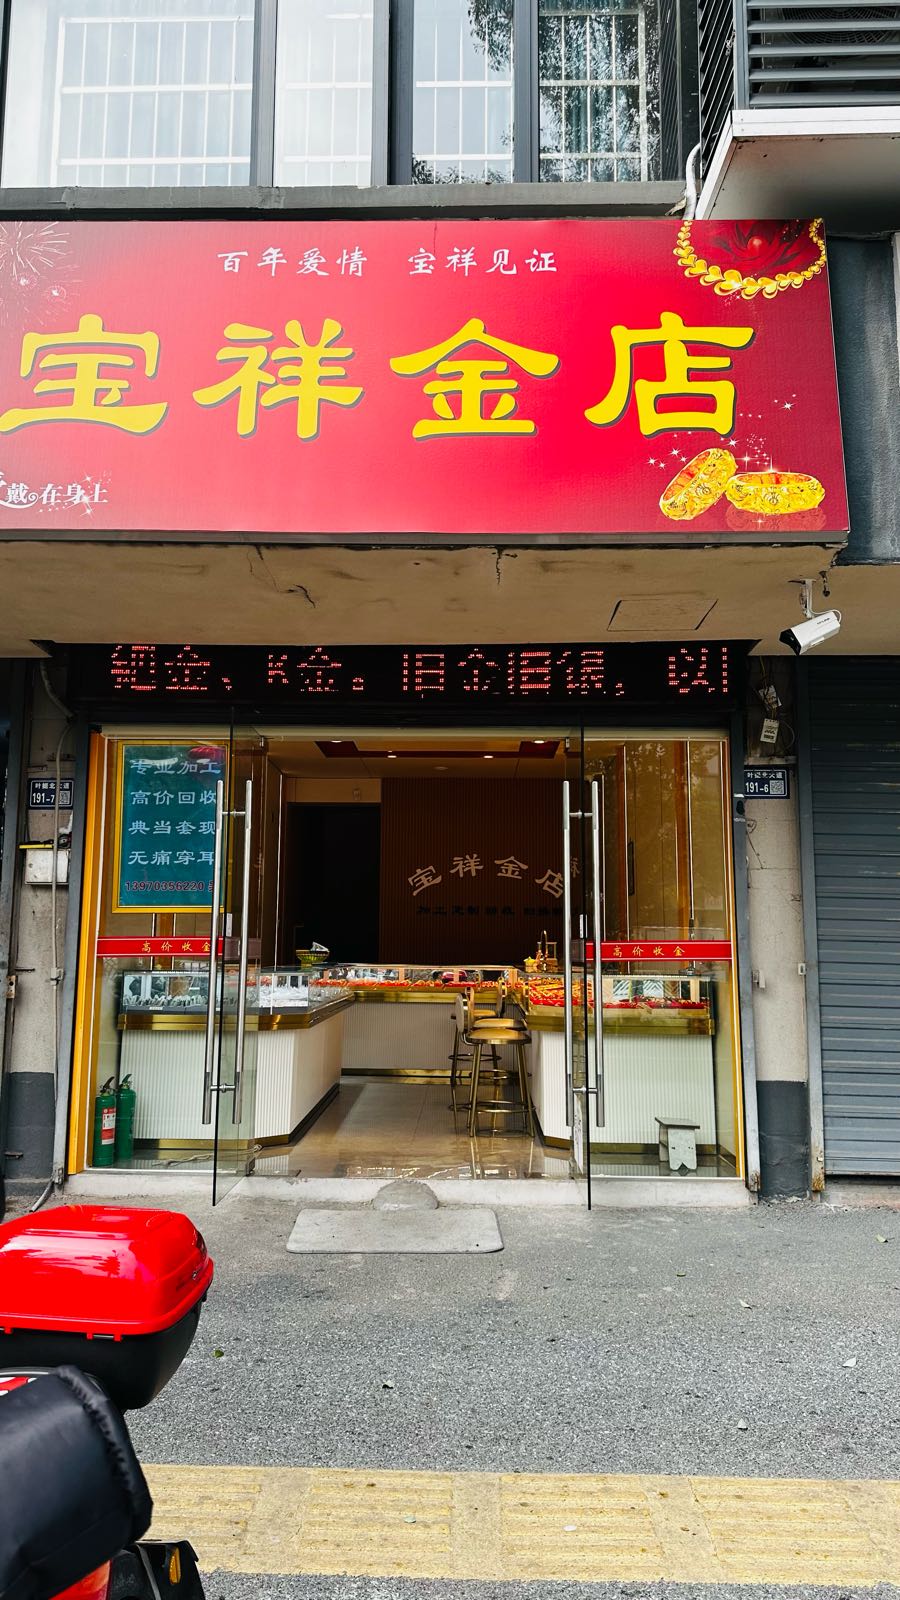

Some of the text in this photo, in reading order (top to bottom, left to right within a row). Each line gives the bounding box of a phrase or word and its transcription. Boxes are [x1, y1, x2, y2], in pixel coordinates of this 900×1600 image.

[217, 246, 558, 277] 百年爱情 宝祥见证
[0, 312, 755, 442] 宝祥金店
[0, 472, 108, 508] 戴在身上
[129, 757, 221, 775] 专业加工
[745, 781, 769, 793] 191-6
[32, 792, 55, 804] 191-7
[130, 790, 216, 806] 高价回收
[128, 820, 216, 836] 典当套现
[128, 850, 215, 866] 无痛穿耳
[407, 853, 565, 899] 宝祥金店
[125, 880, 205, 892] 13970356220
[141, 940, 211, 953] 高价收金
[612, 945, 686, 958] 高价收金
